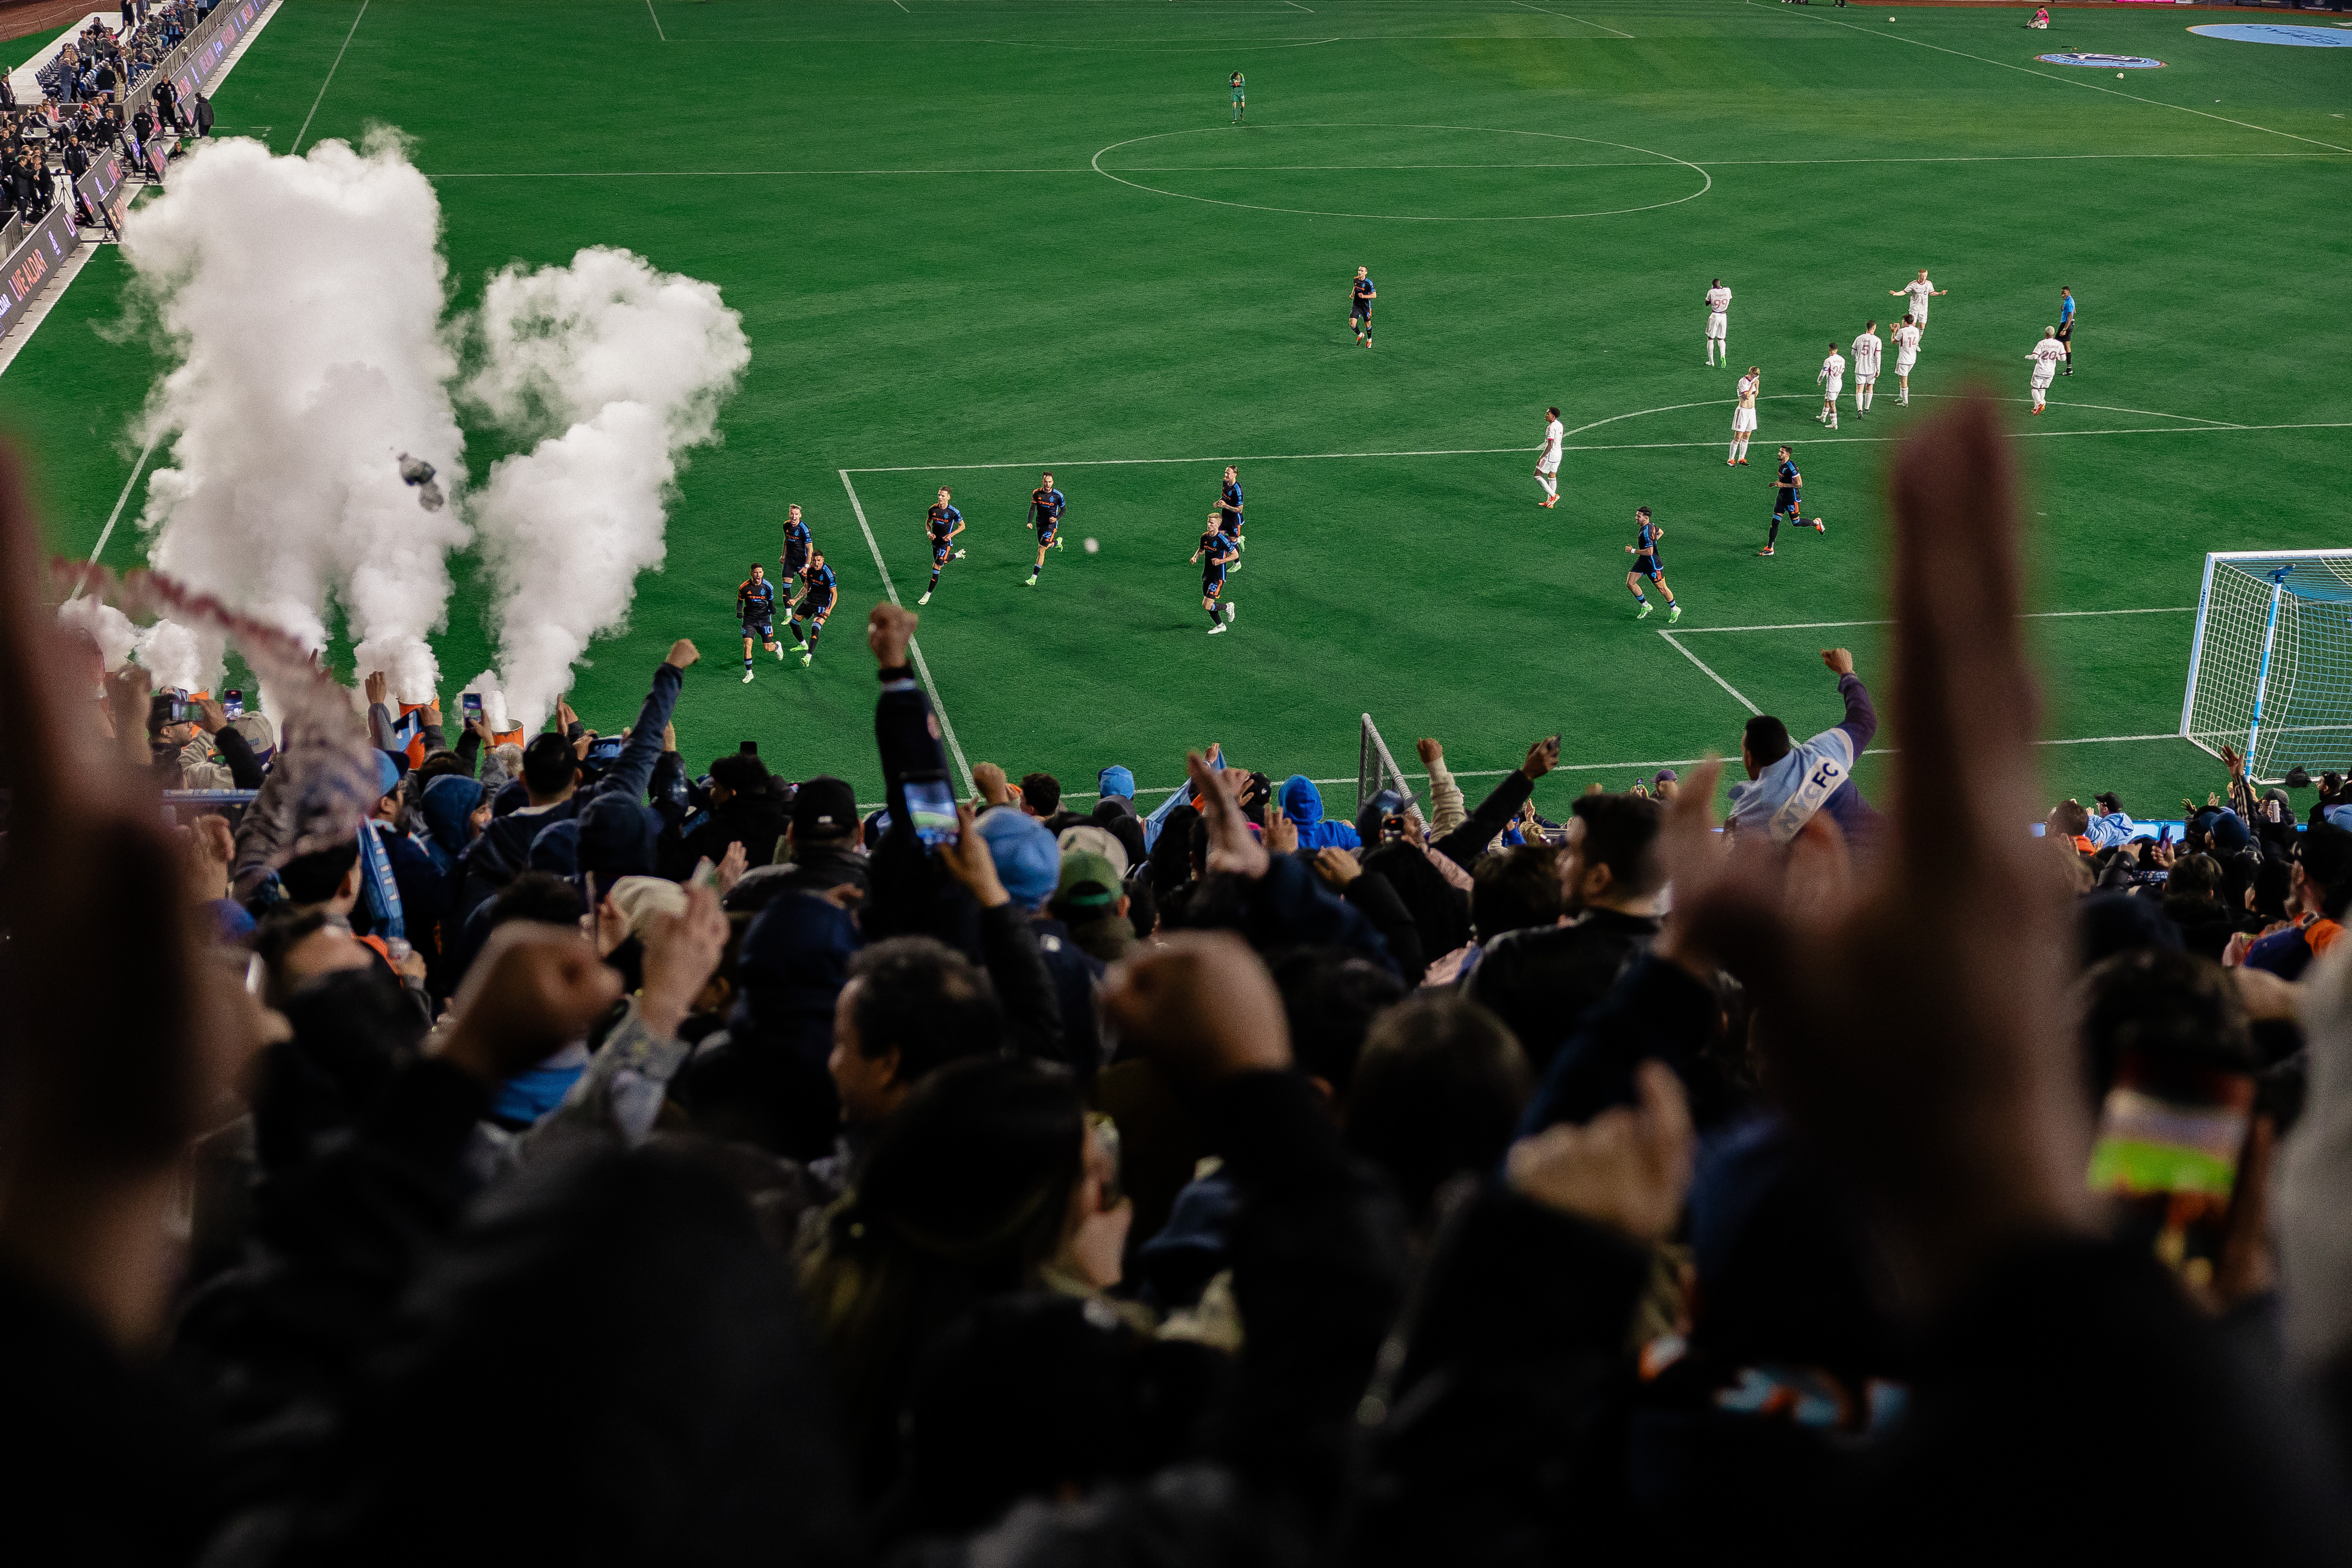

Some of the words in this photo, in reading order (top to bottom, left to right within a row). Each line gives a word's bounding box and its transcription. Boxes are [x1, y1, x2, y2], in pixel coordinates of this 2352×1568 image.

[8, 268, 30, 302] LIVE
[21, 248, 48, 288] ALDAR
[1714, 299, 1728, 309] 99
[1861, 344, 1869, 355] 5
[2041, 350, 2057, 360] 20
[938, 548, 947, 557] 17
